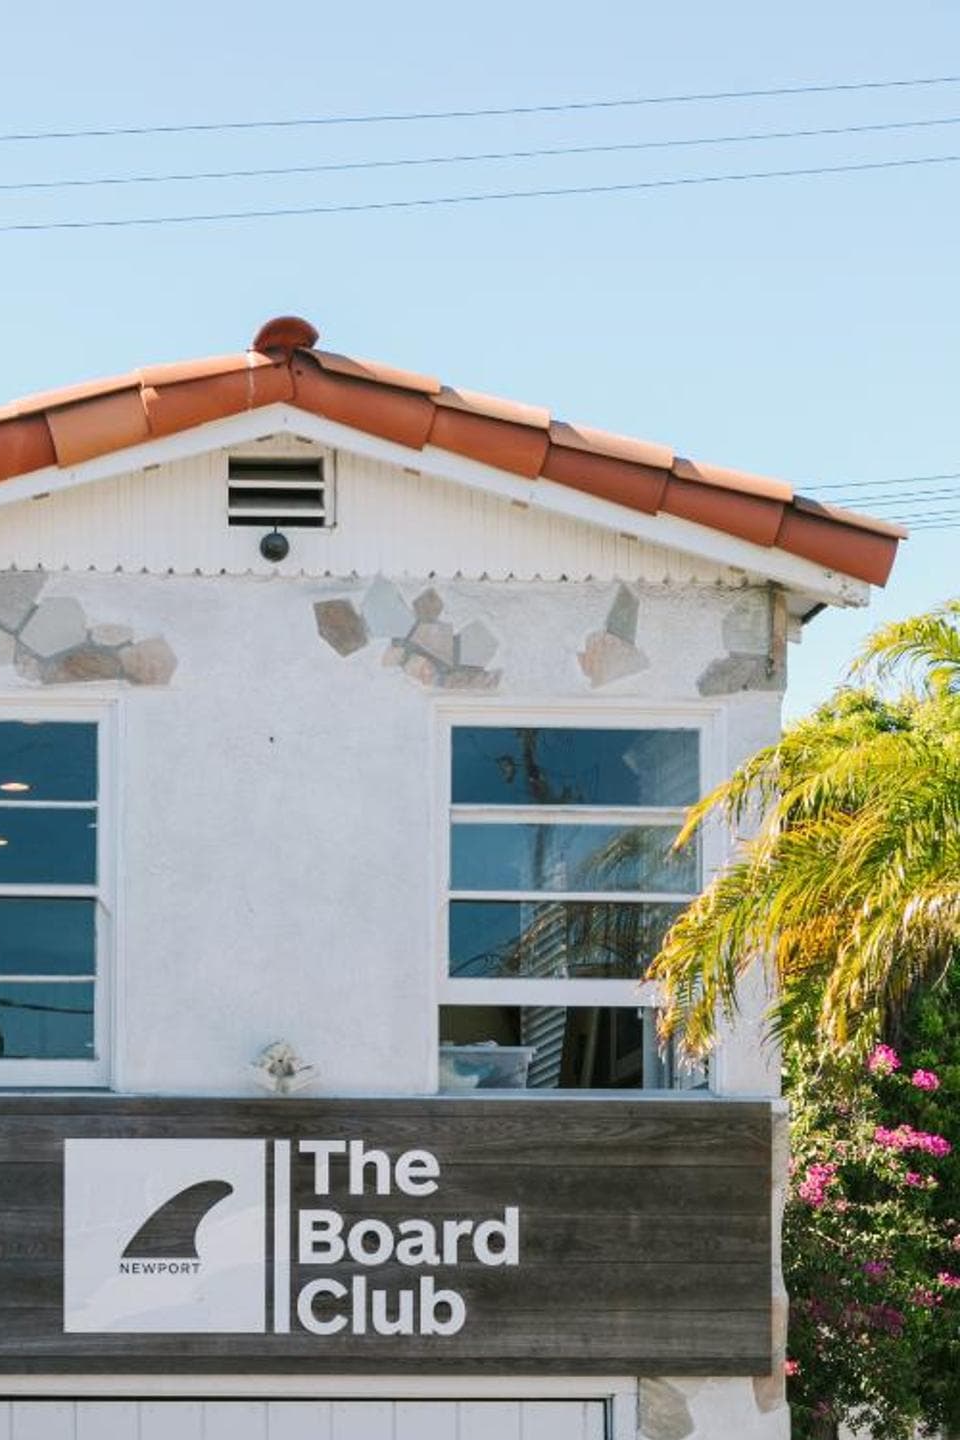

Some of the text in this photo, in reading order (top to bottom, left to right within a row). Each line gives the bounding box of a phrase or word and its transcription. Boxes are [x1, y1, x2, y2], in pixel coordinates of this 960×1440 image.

[298, 1139, 441, 1196] The
[298, 1206, 520, 1266] Board
[119, 1262, 201, 1274] NEWPORT
[296, 1275, 467, 1336] Club
